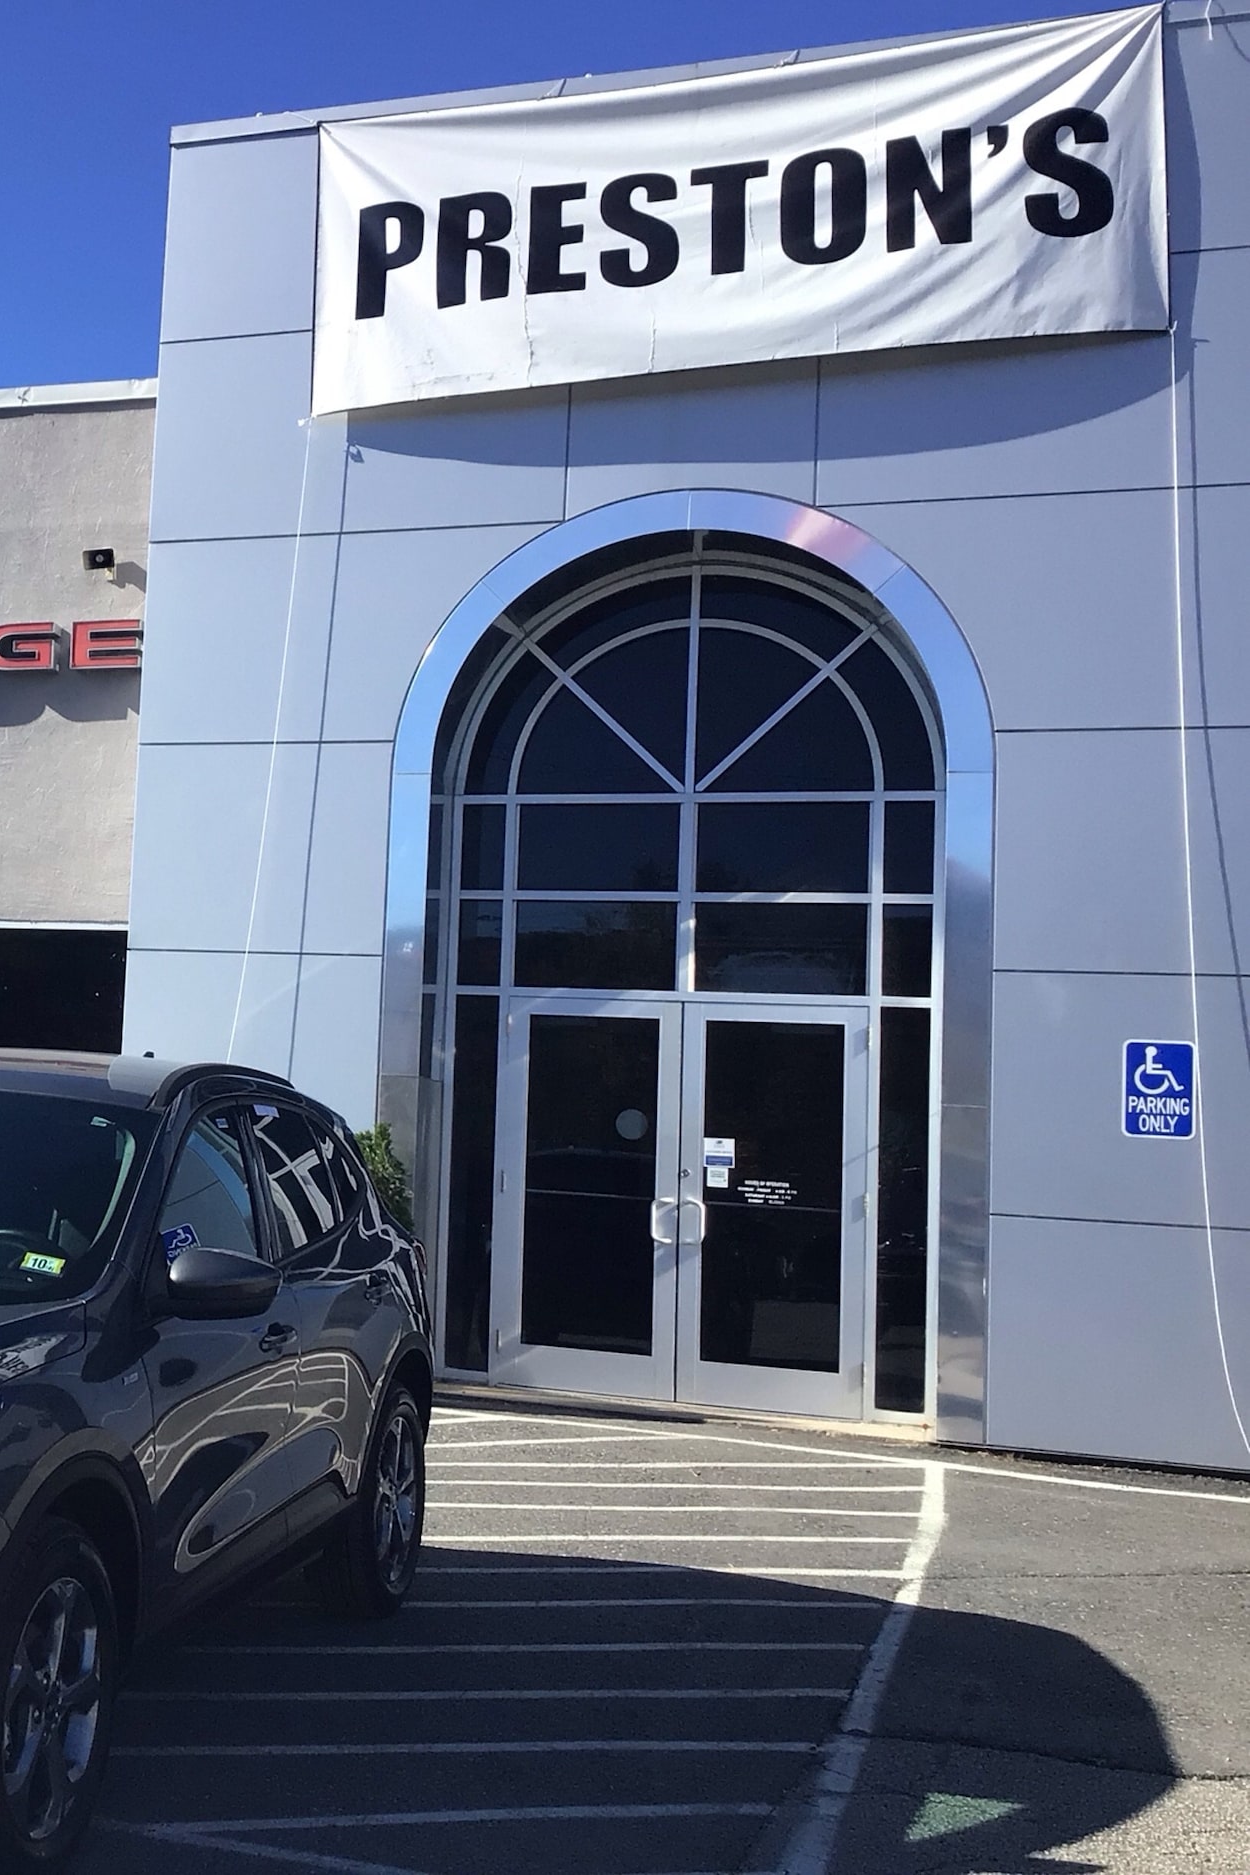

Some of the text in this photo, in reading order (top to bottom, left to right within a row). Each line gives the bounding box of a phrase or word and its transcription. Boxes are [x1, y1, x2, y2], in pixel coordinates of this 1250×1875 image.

[355, 107, 1114, 320] PRESTON'S
[1128, 1096, 1190, 1115] PARKING
[1138, 1114, 1179, 1133] ONLY
